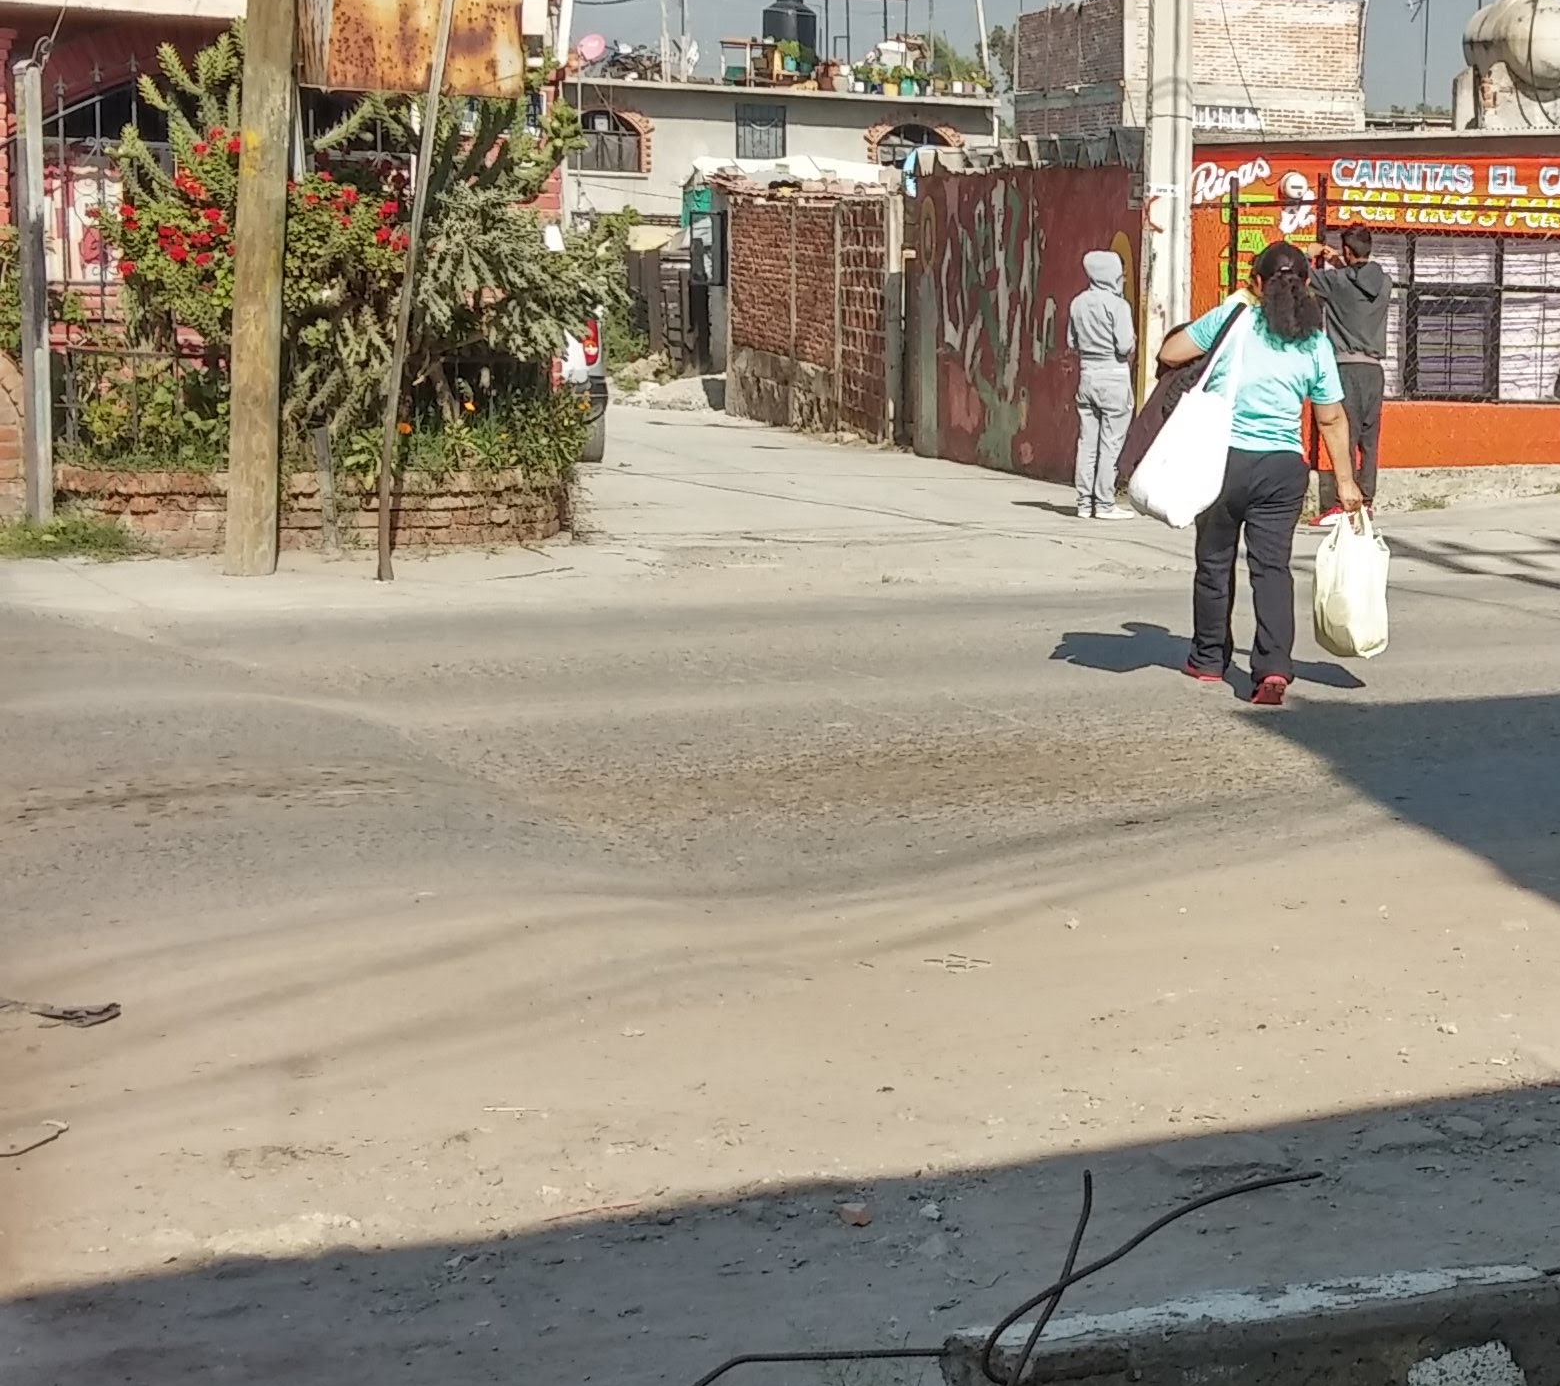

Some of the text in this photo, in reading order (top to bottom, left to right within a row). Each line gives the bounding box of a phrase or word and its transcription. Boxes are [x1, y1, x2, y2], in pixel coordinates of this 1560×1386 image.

[1190, 156, 1271, 204] Ricas
[1331, 158, 1474, 194] CARNITAS
[1488, 164, 1528, 195] EL
